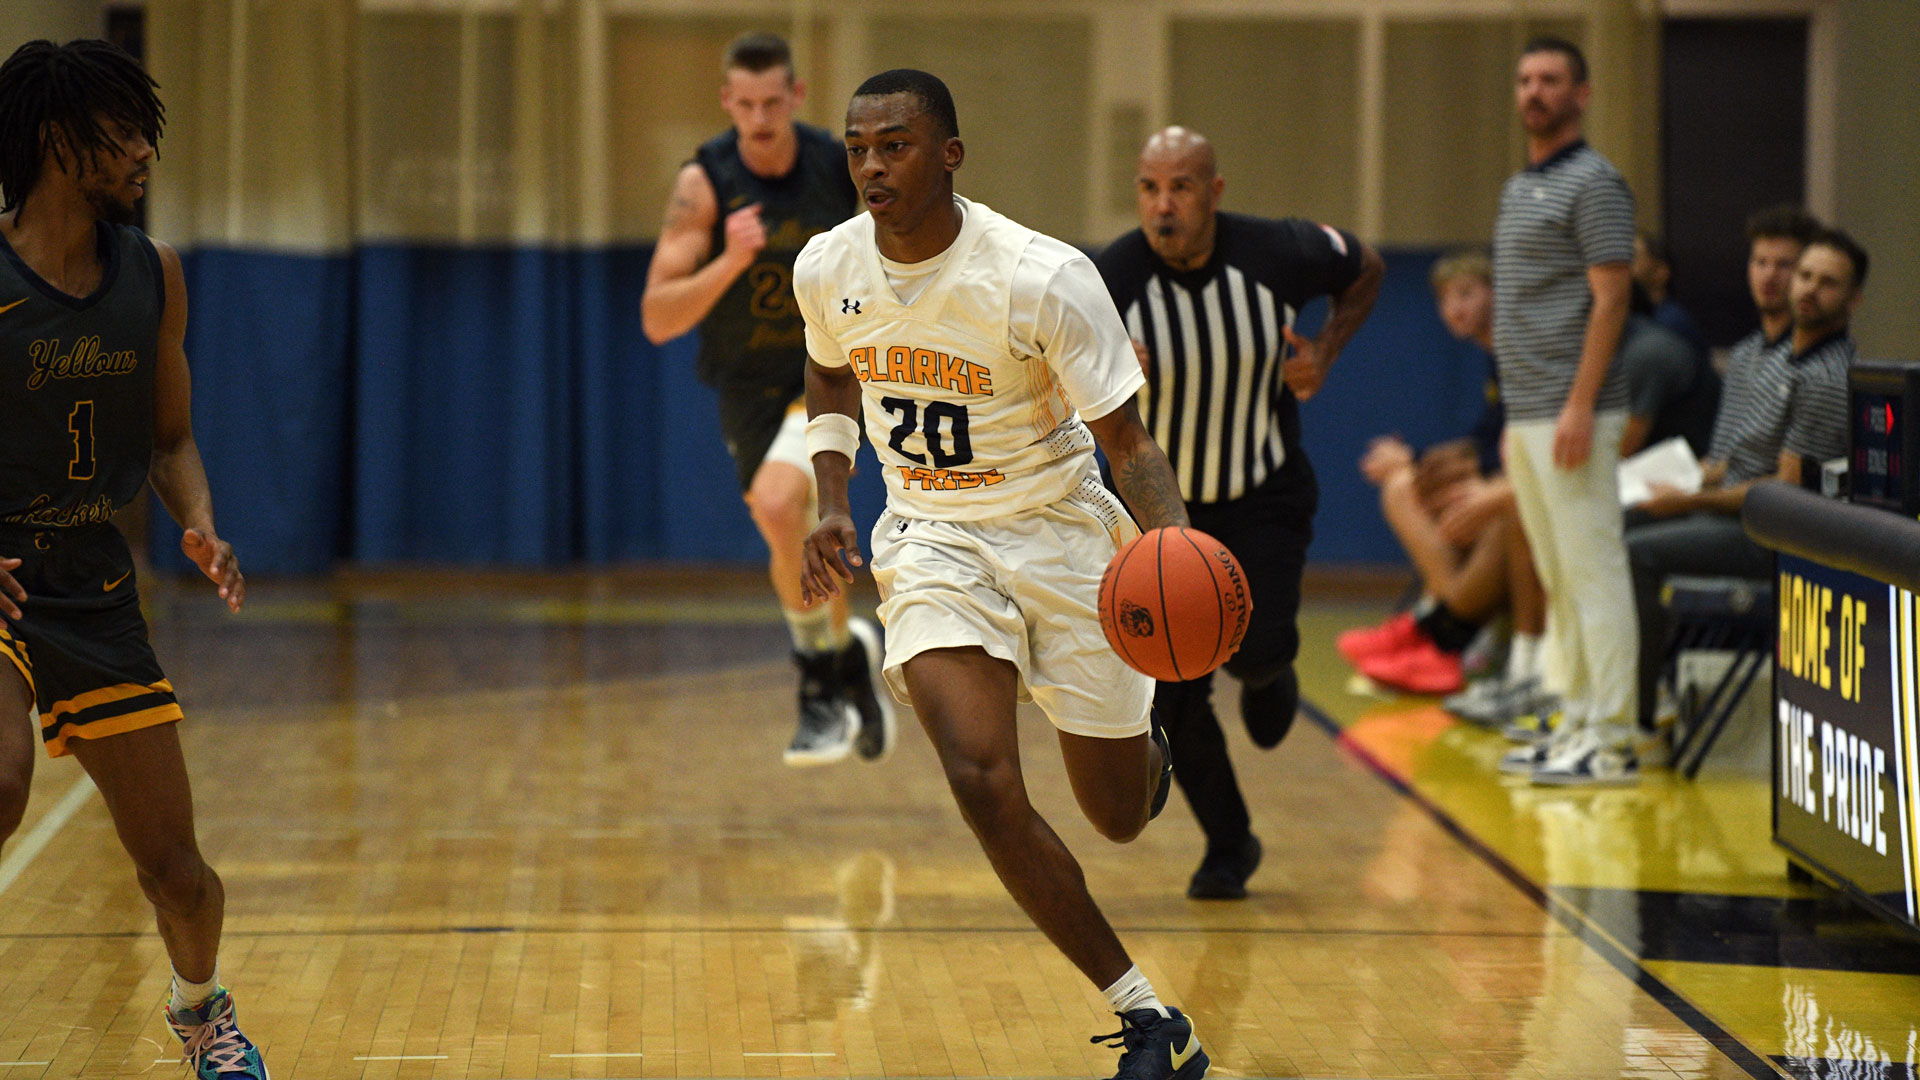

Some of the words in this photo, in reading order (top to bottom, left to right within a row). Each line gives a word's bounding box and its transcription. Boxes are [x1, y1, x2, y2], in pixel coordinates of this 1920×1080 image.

[27, 335, 138, 390] Yellow
[849, 345, 994, 396] CLARKE
[68, 400, 96, 481] 1
[880, 396, 974, 468] 20
[896, 465, 1006, 491] PRIDE
[1779, 570, 1833, 691] HOME
[1840, 594, 1867, 704] OF
[1779, 698, 1816, 816] THE
[1821, 720, 1887, 857] PRIDE
